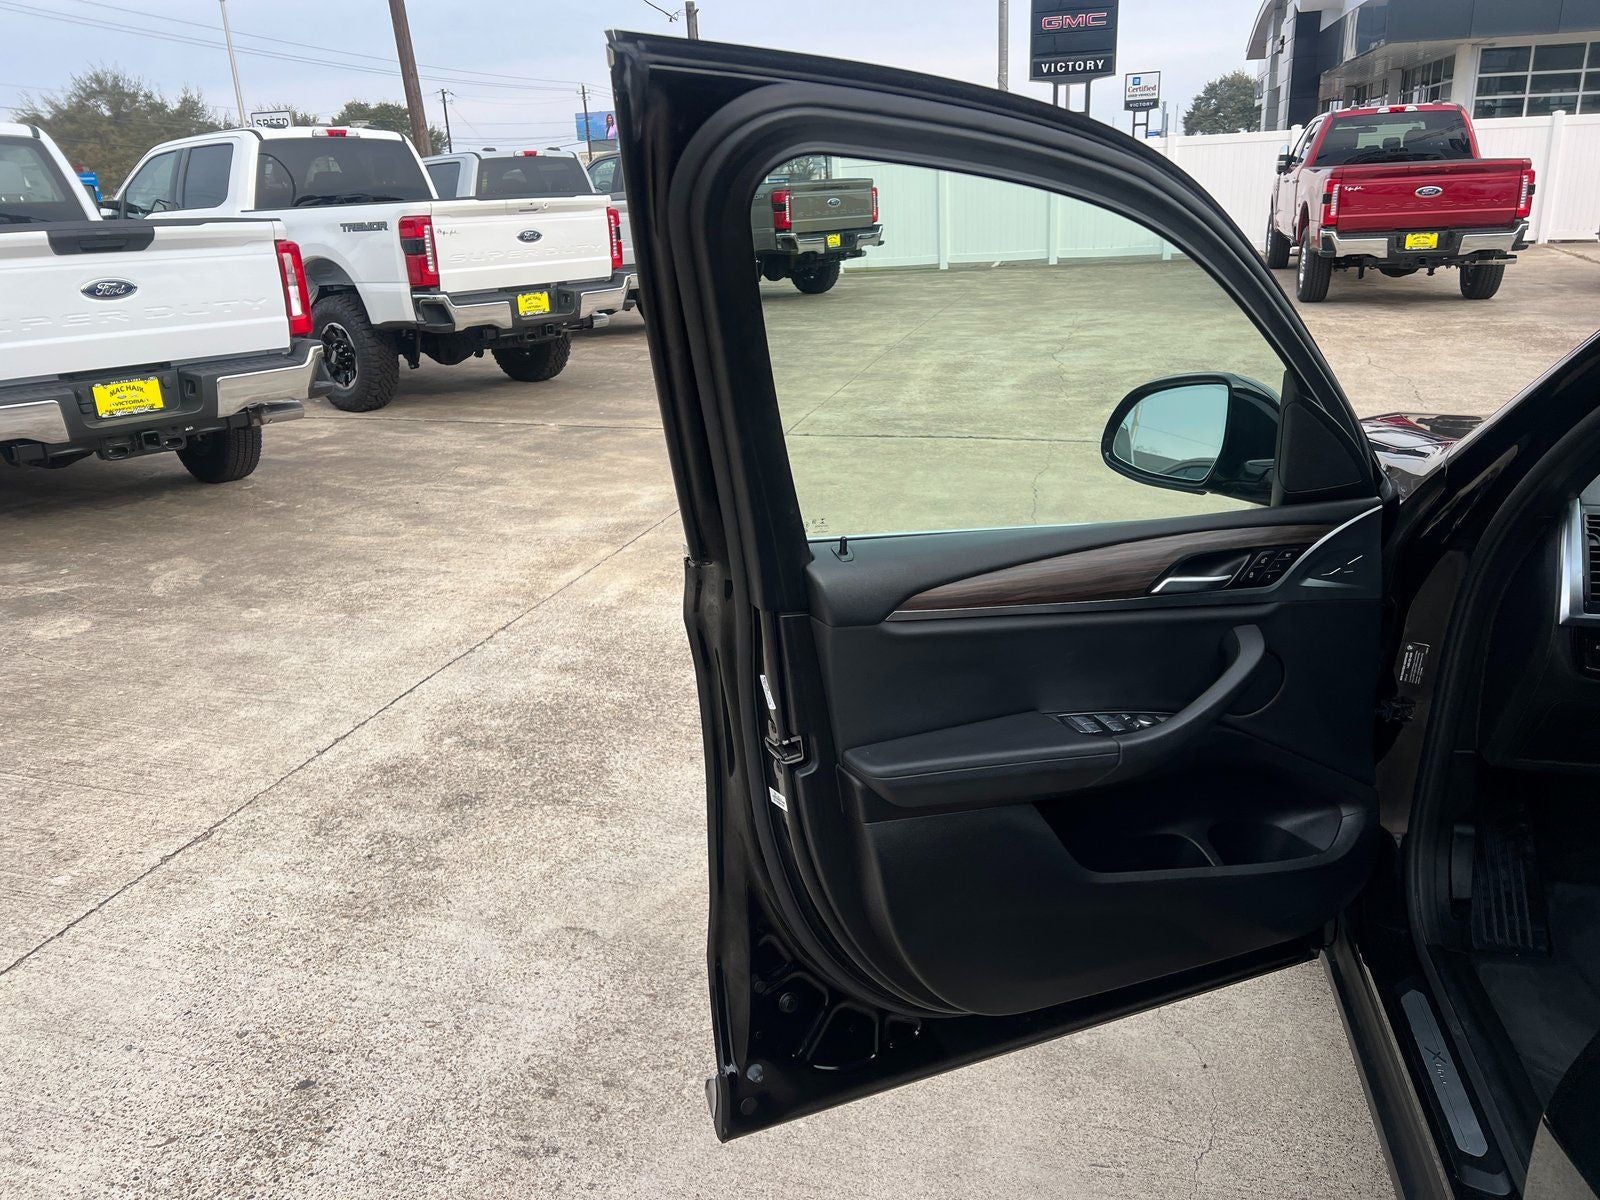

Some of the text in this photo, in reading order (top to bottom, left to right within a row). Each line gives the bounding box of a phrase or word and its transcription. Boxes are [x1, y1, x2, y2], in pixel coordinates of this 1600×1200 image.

[1041, 12, 1107, 30] GMC
[1041, 59, 1105, 73] VICTORY
[1127, 84, 1157, 93] Certified
[256, 117, 289, 128] SPEED
[339, 220, 389, 232] TREMOR
[95, 281, 126, 296] Ford
[110, 385, 125, 397] MAC
